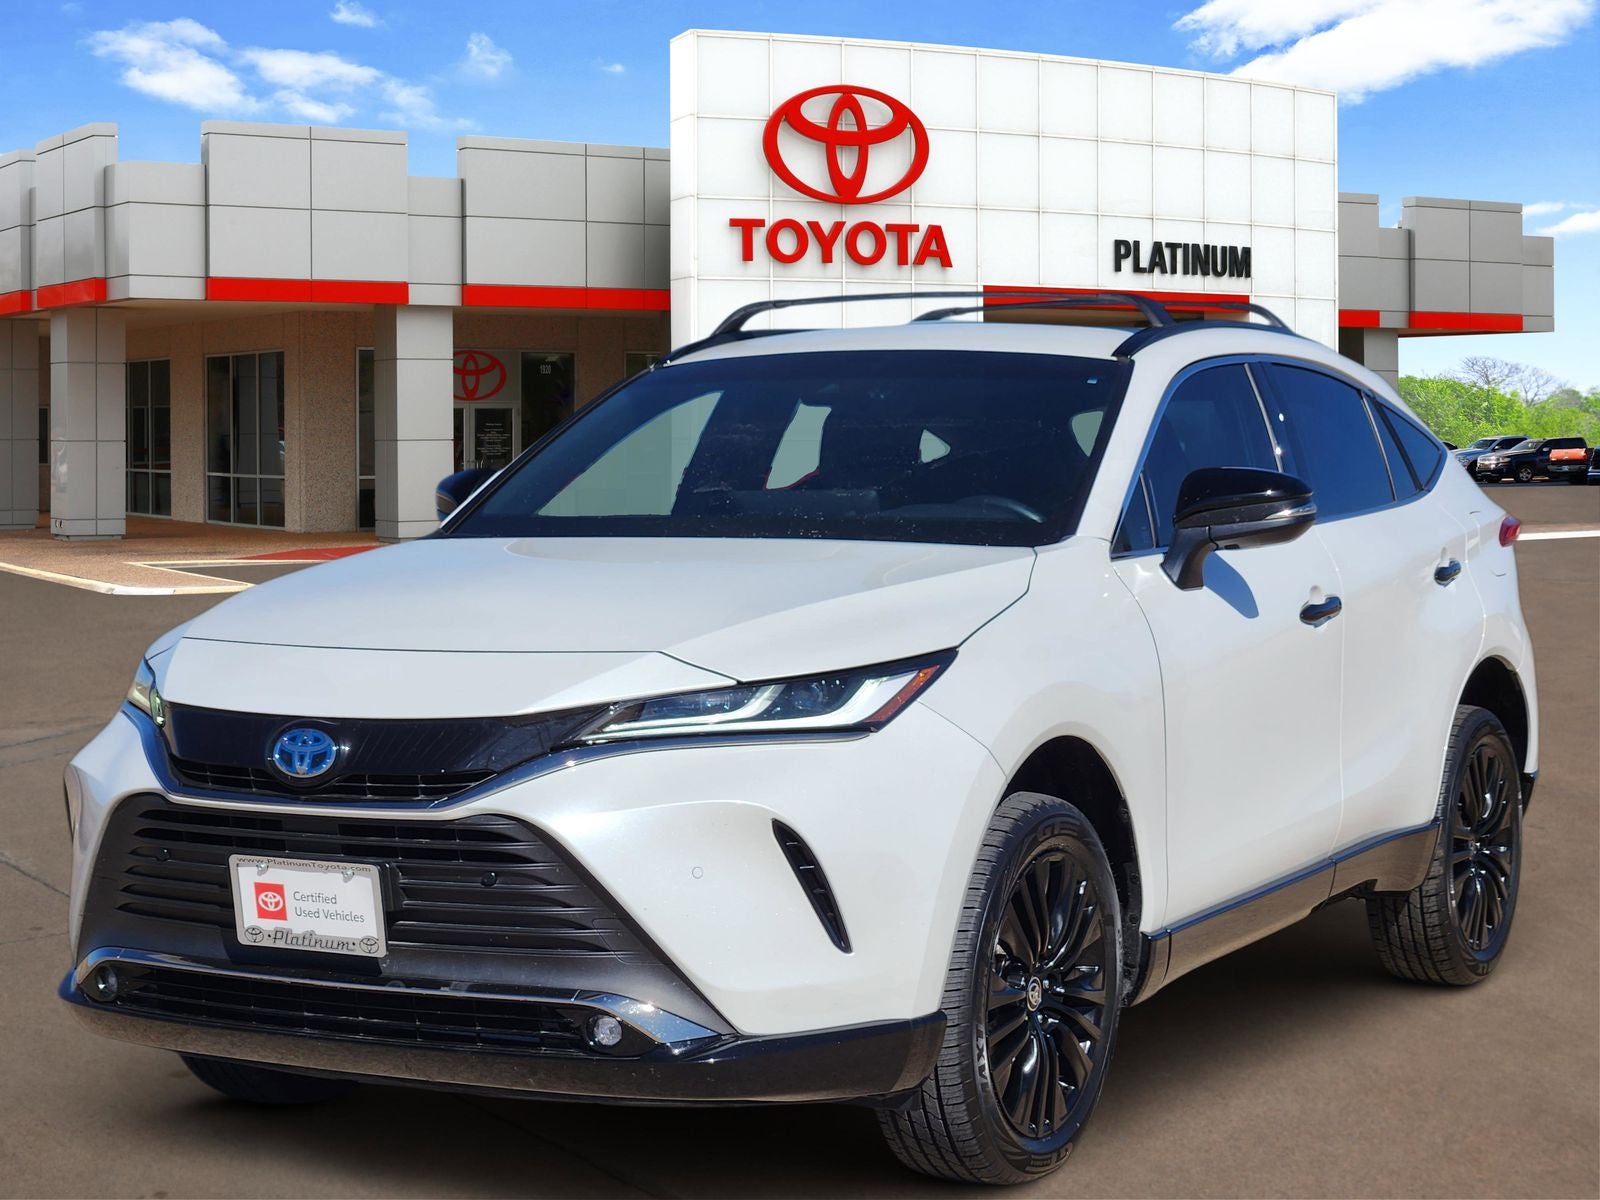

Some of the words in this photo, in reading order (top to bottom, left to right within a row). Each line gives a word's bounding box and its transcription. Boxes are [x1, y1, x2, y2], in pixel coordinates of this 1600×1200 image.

[729, 217, 953, 268] TOYOTA
[1113, 239, 1251, 278] PLATINUM
[237, 856, 372, 873] www.PlatinumToyota.com
[293, 891, 337, 905] Certified
[294, 906, 320, 919] Used
[322, 909, 365, 923] Vehicles
[272, 930, 356, 952] Platinum
